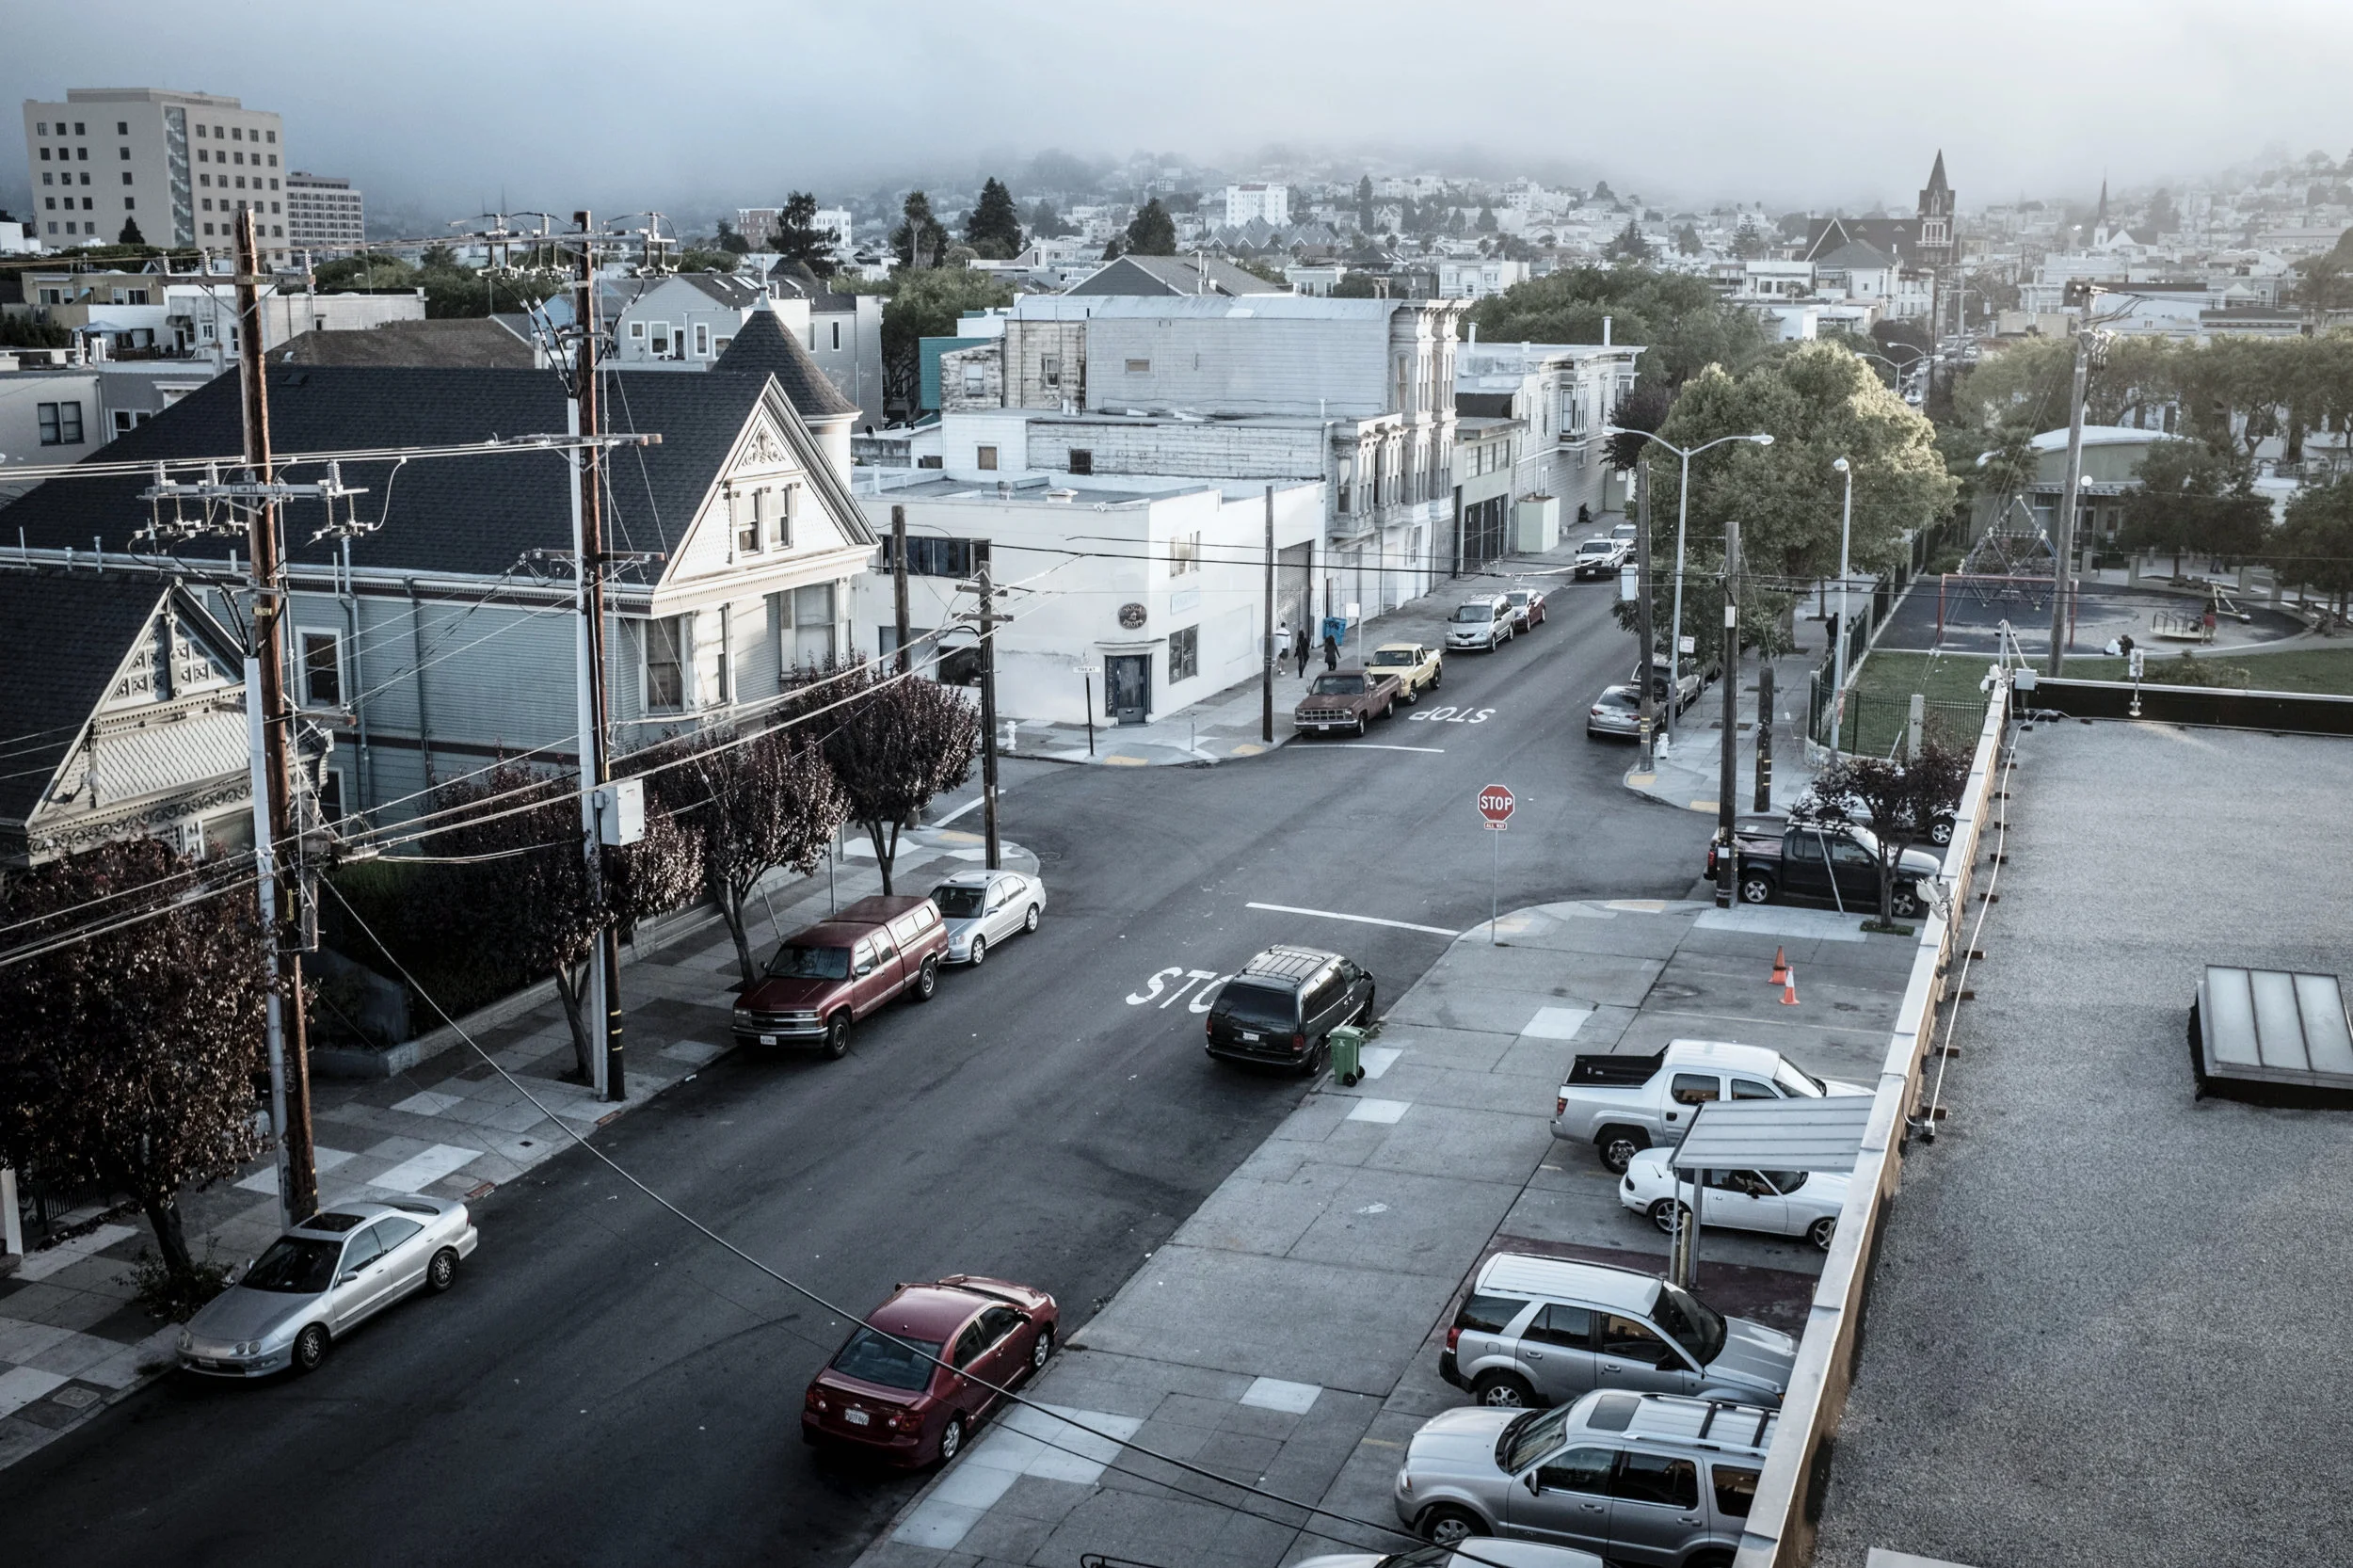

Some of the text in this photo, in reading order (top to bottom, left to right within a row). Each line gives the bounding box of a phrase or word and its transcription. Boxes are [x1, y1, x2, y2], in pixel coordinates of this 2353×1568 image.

[1408, 706, 1497, 724] STOP
[1481, 795, 1513, 811] STOP
[1126, 967, 1234, 1014] STO
